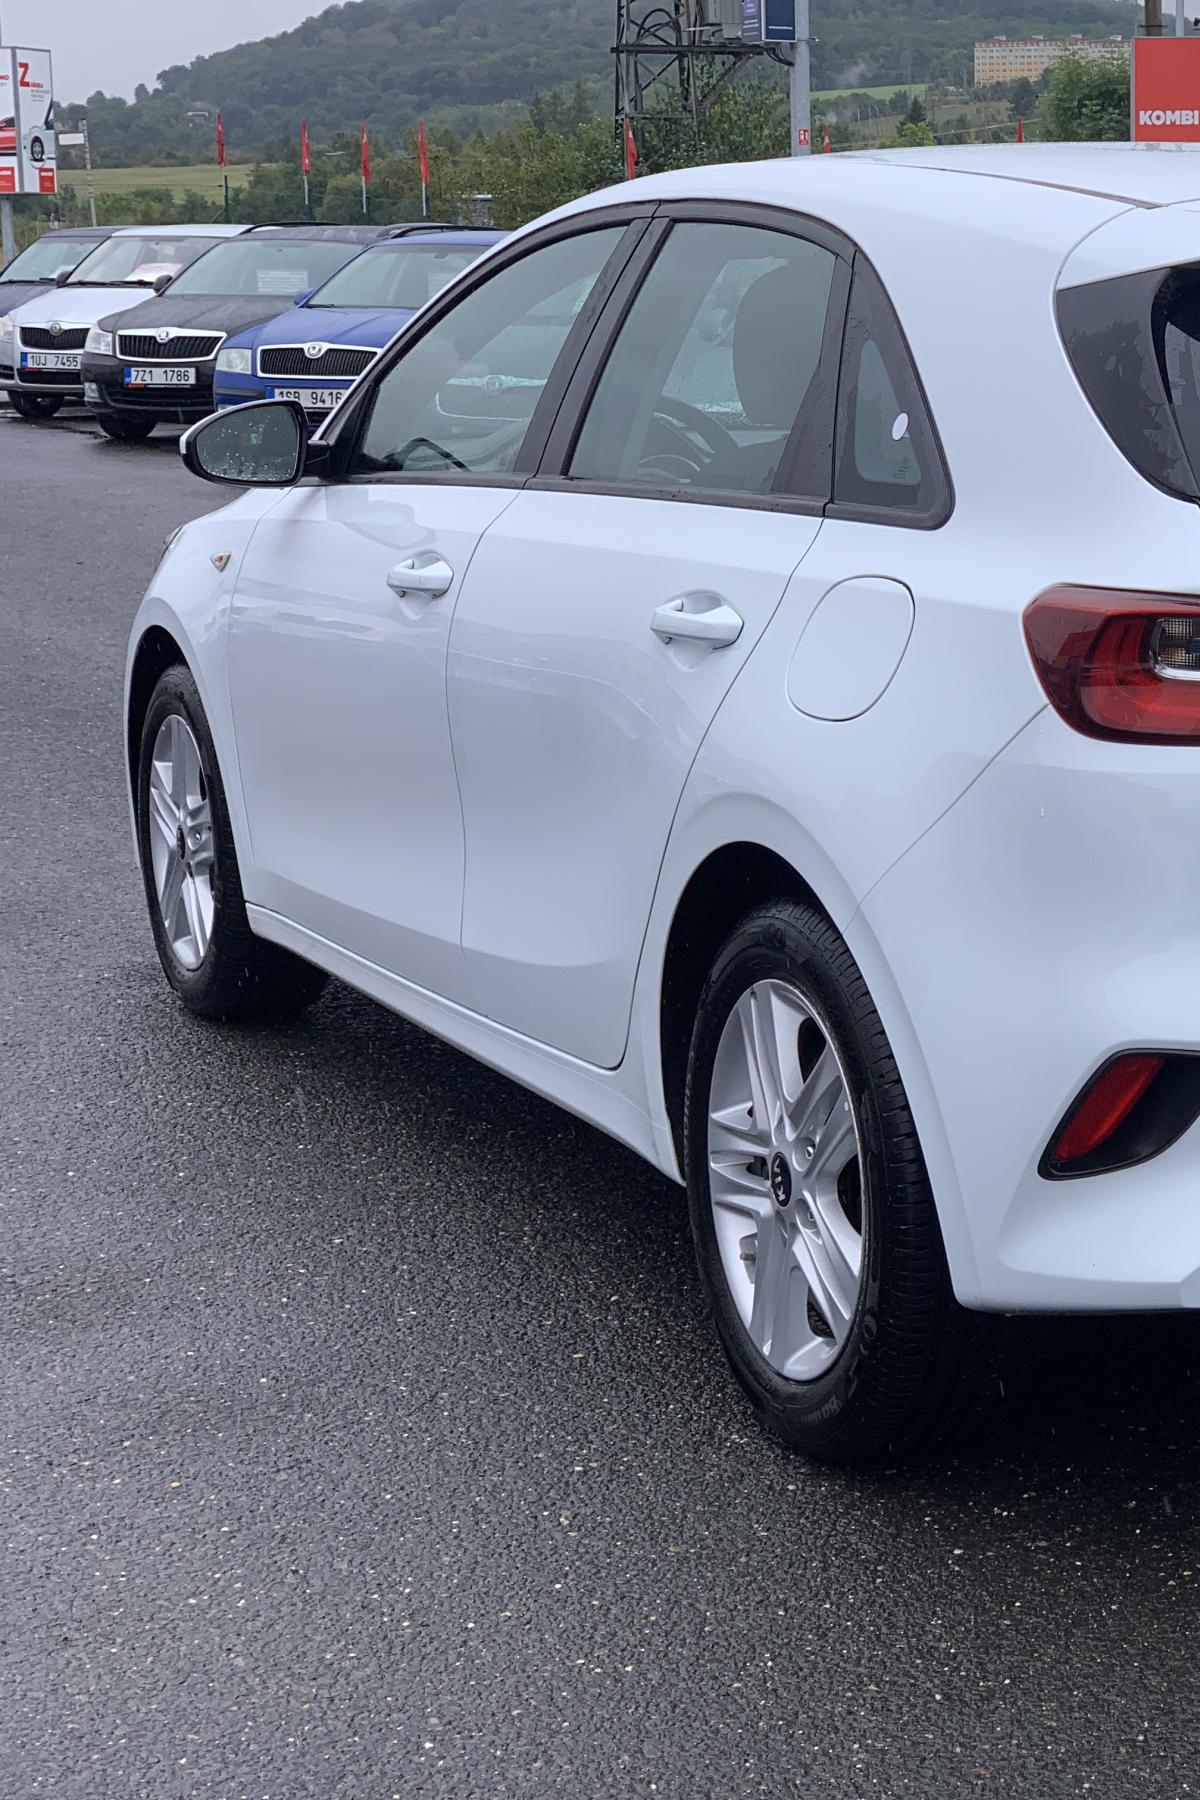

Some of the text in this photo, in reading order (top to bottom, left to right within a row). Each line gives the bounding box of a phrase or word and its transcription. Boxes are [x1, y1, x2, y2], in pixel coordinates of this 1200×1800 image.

[1139, 110, 1200, 126] KOMBI
[30, 355, 79, 368] 1UJ 7455
[133, 370, 190, 382] 7Z1 1786
[773, 1156, 786, 1202] KIA
